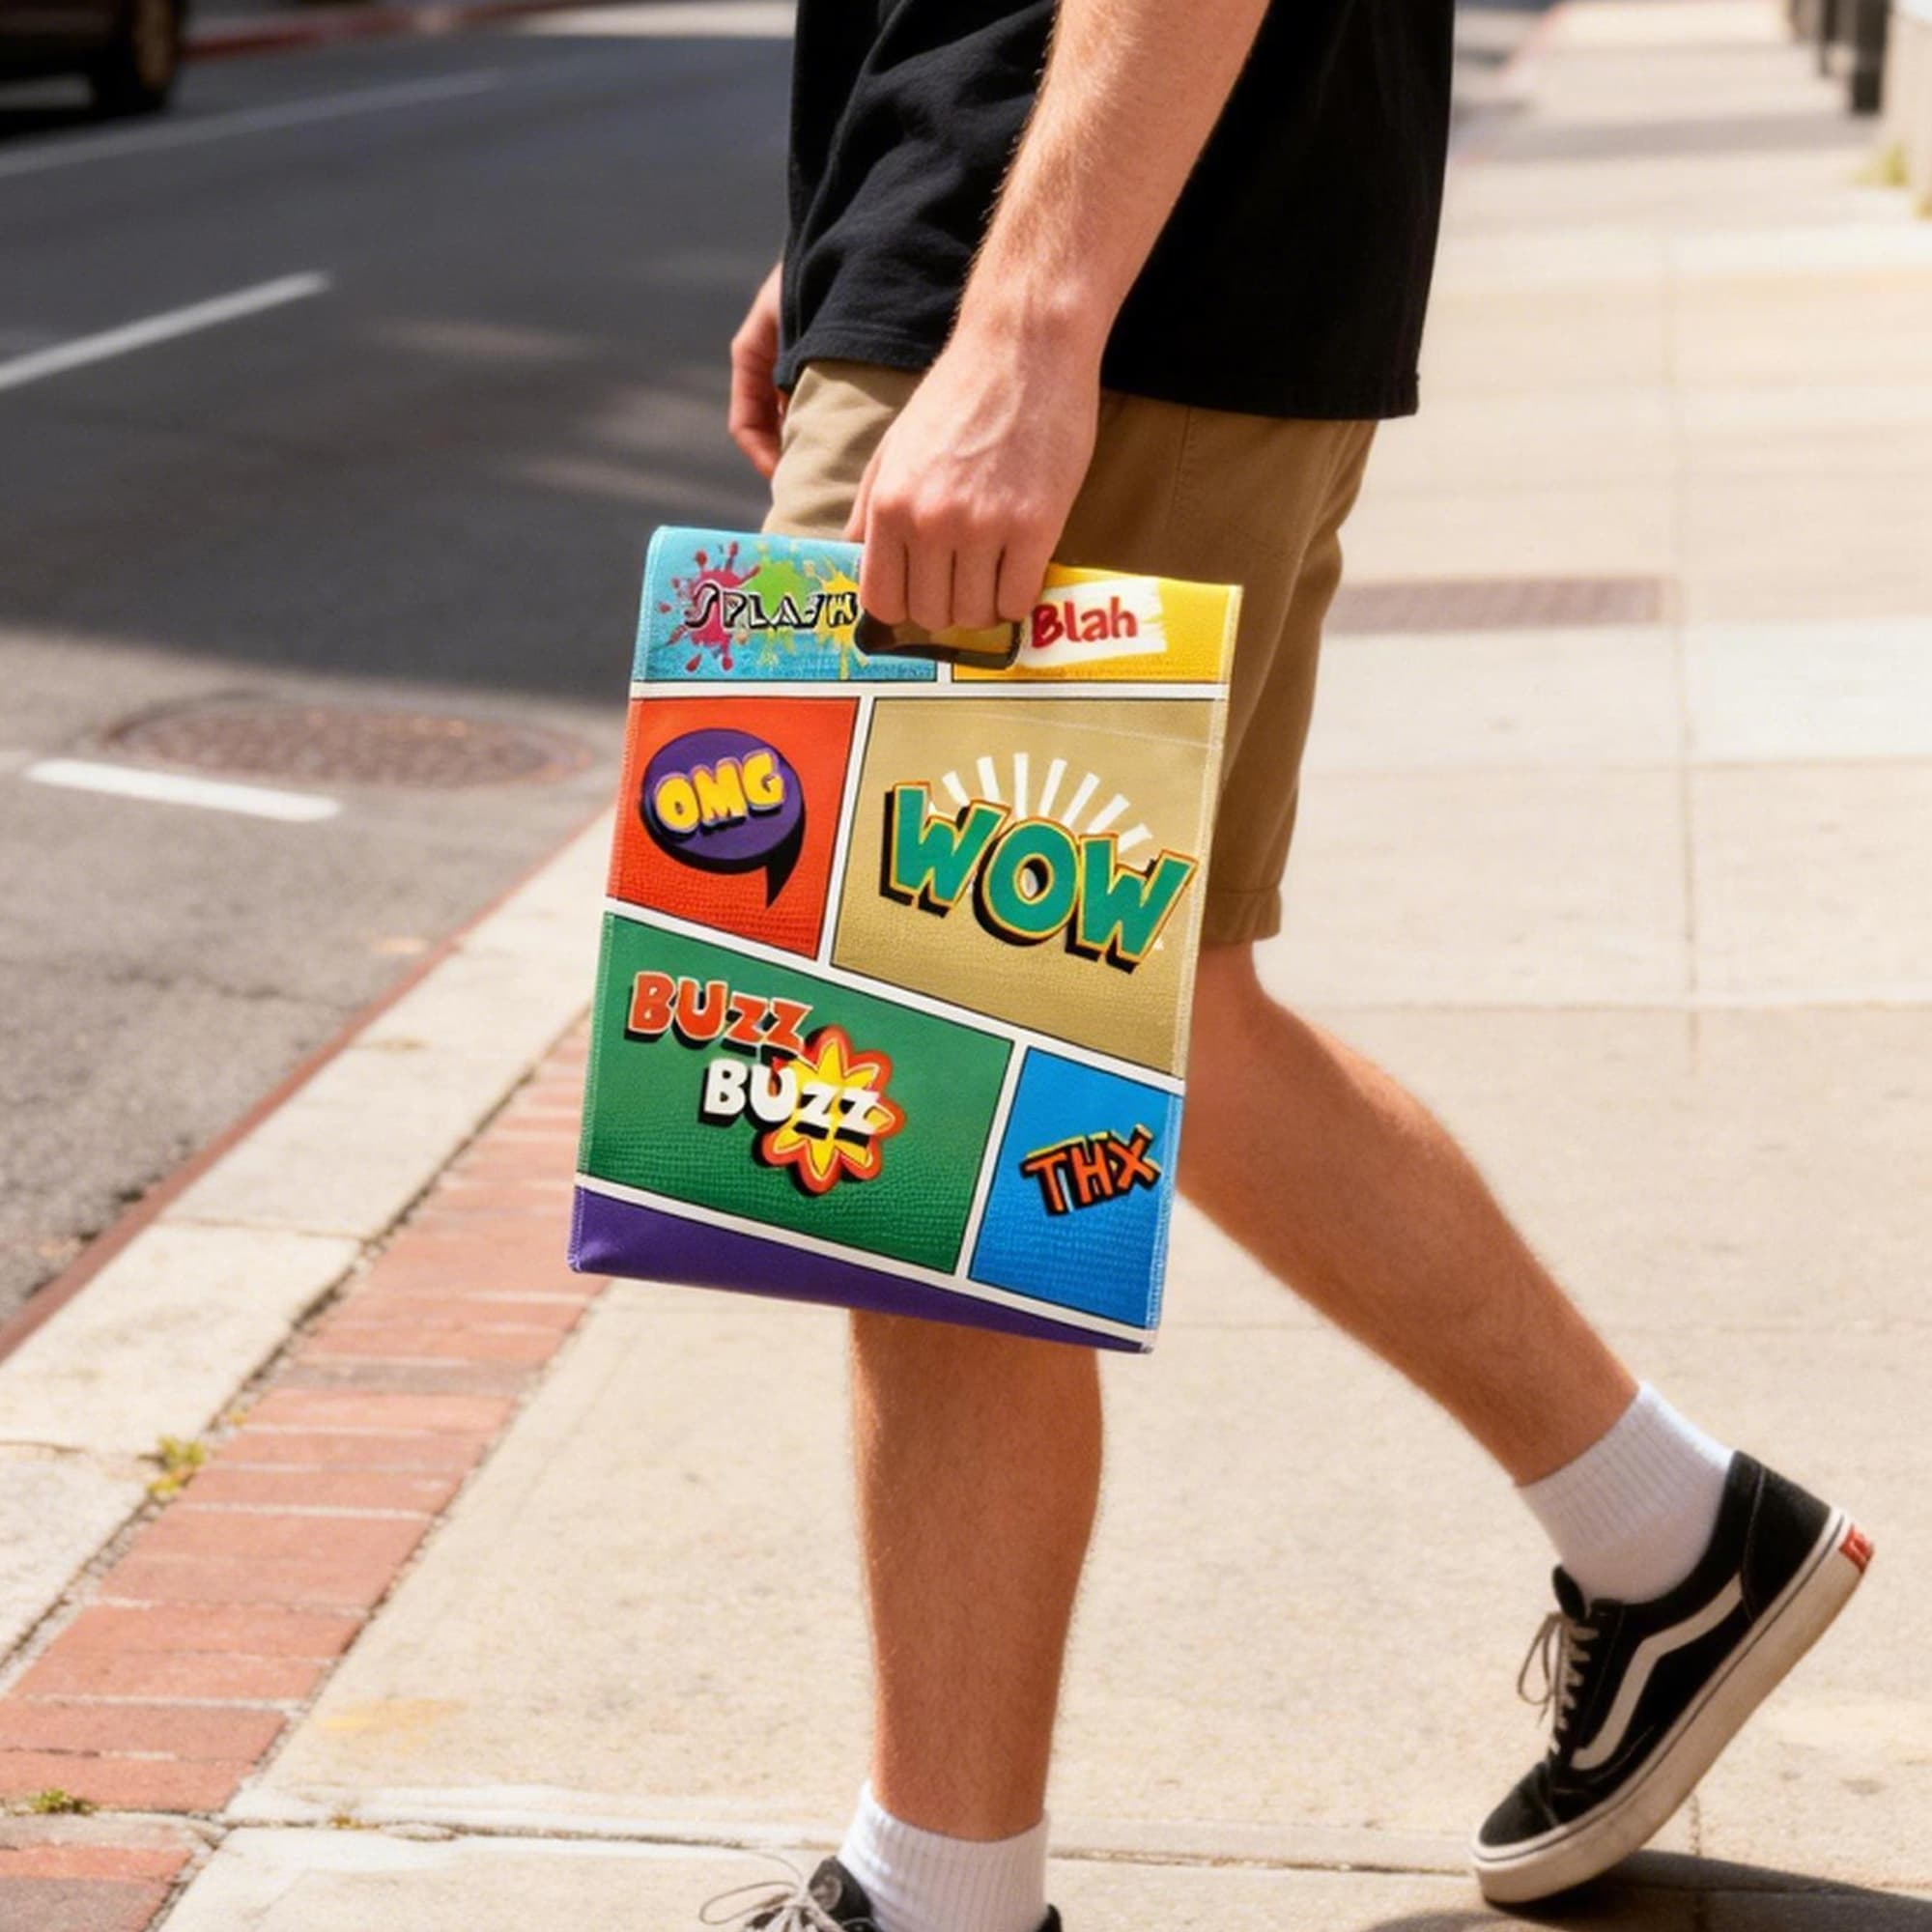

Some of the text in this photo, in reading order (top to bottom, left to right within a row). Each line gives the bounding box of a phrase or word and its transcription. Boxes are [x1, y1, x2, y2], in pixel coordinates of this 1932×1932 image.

[1031, 595, 1139, 649] Blah
[654, 750, 786, 835] OMG
[880, 781, 1197, 974] WOW
[626, 971, 812, 1057] BUZZ
[699, 1059, 881, 1142] BUZZ
[1020, 1123, 1161, 1215] THX
